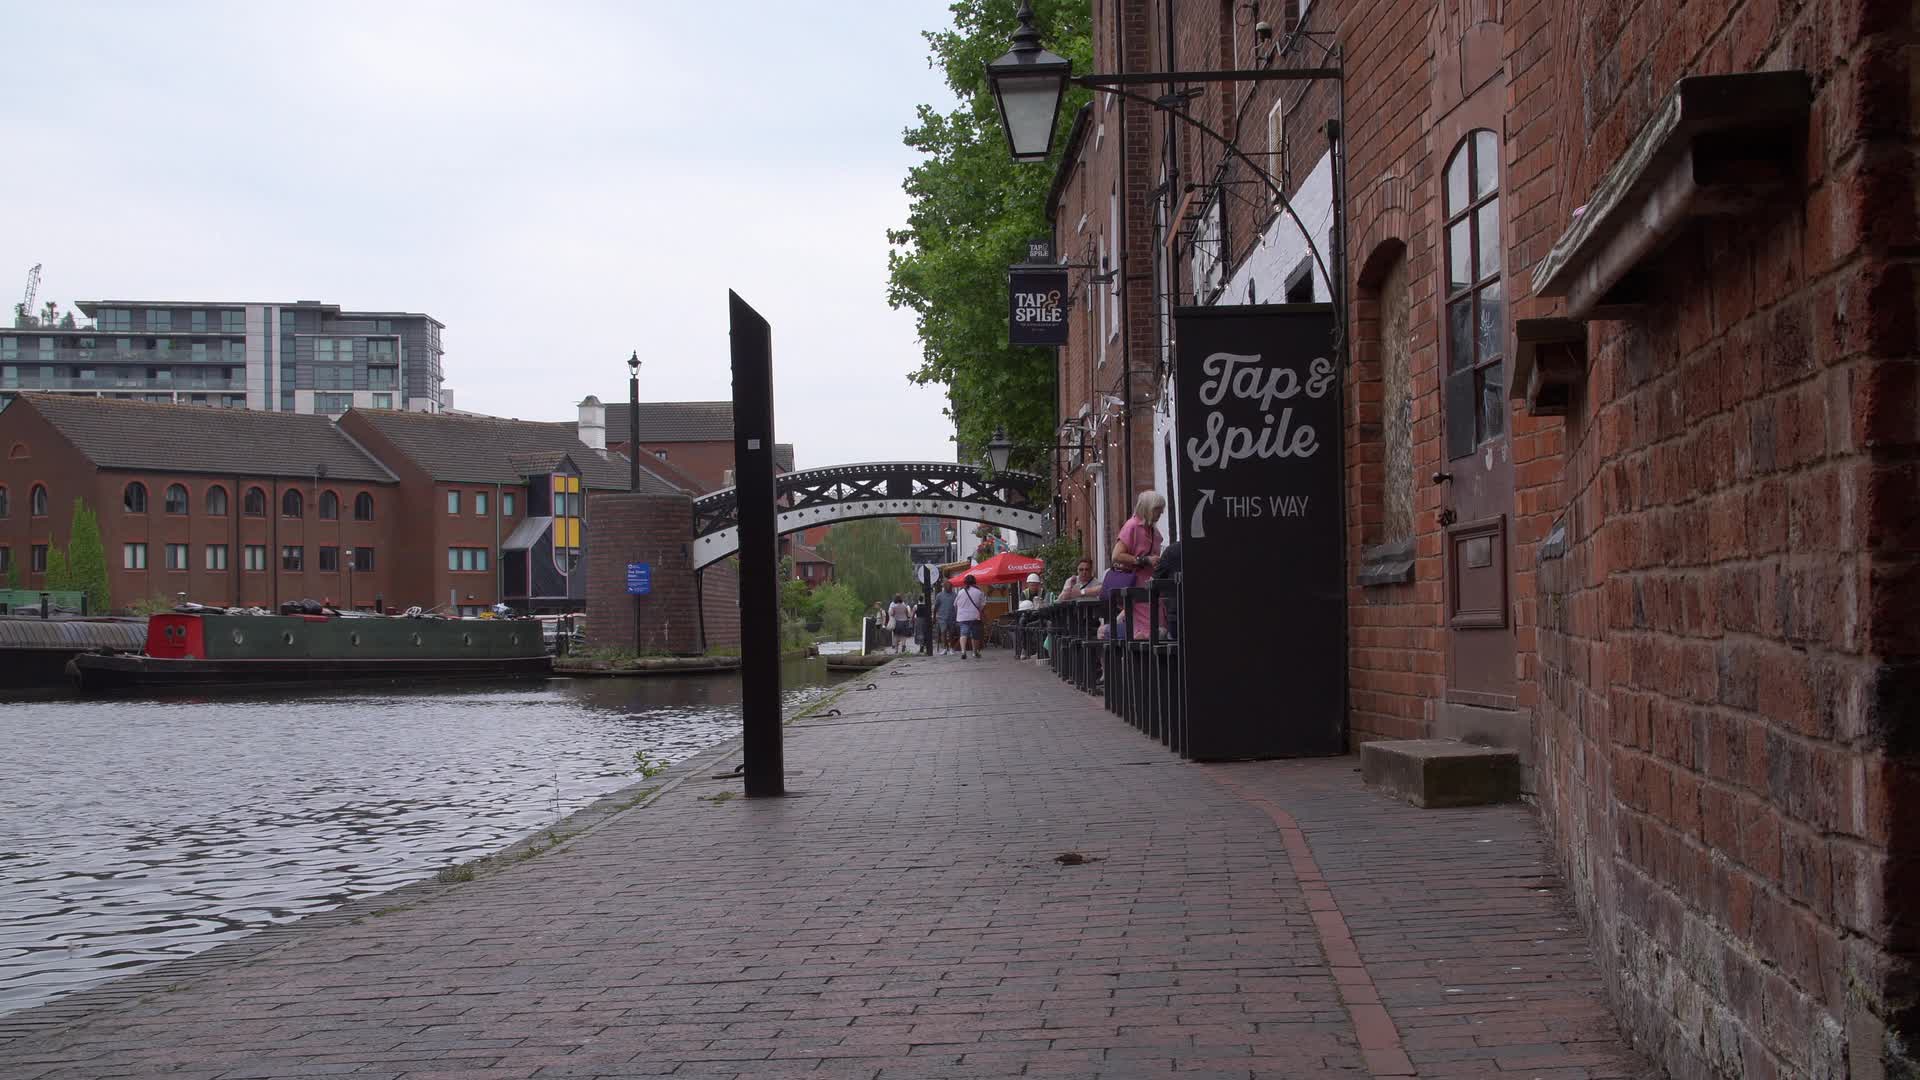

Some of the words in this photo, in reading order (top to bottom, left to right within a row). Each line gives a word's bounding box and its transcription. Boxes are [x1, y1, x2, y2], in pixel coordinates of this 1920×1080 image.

[1015, 293, 1047, 307] TAP
[1043, 290, 1061, 310] &
[1015, 308, 1062, 322] SPILE
[1199, 352, 1302, 411] Tap
[1305, 357, 1336, 399] &
[1186, 408, 1320, 472] Spile
[1222, 496, 1263, 518] THIS
[1269, 495, 1309, 518] WAY
